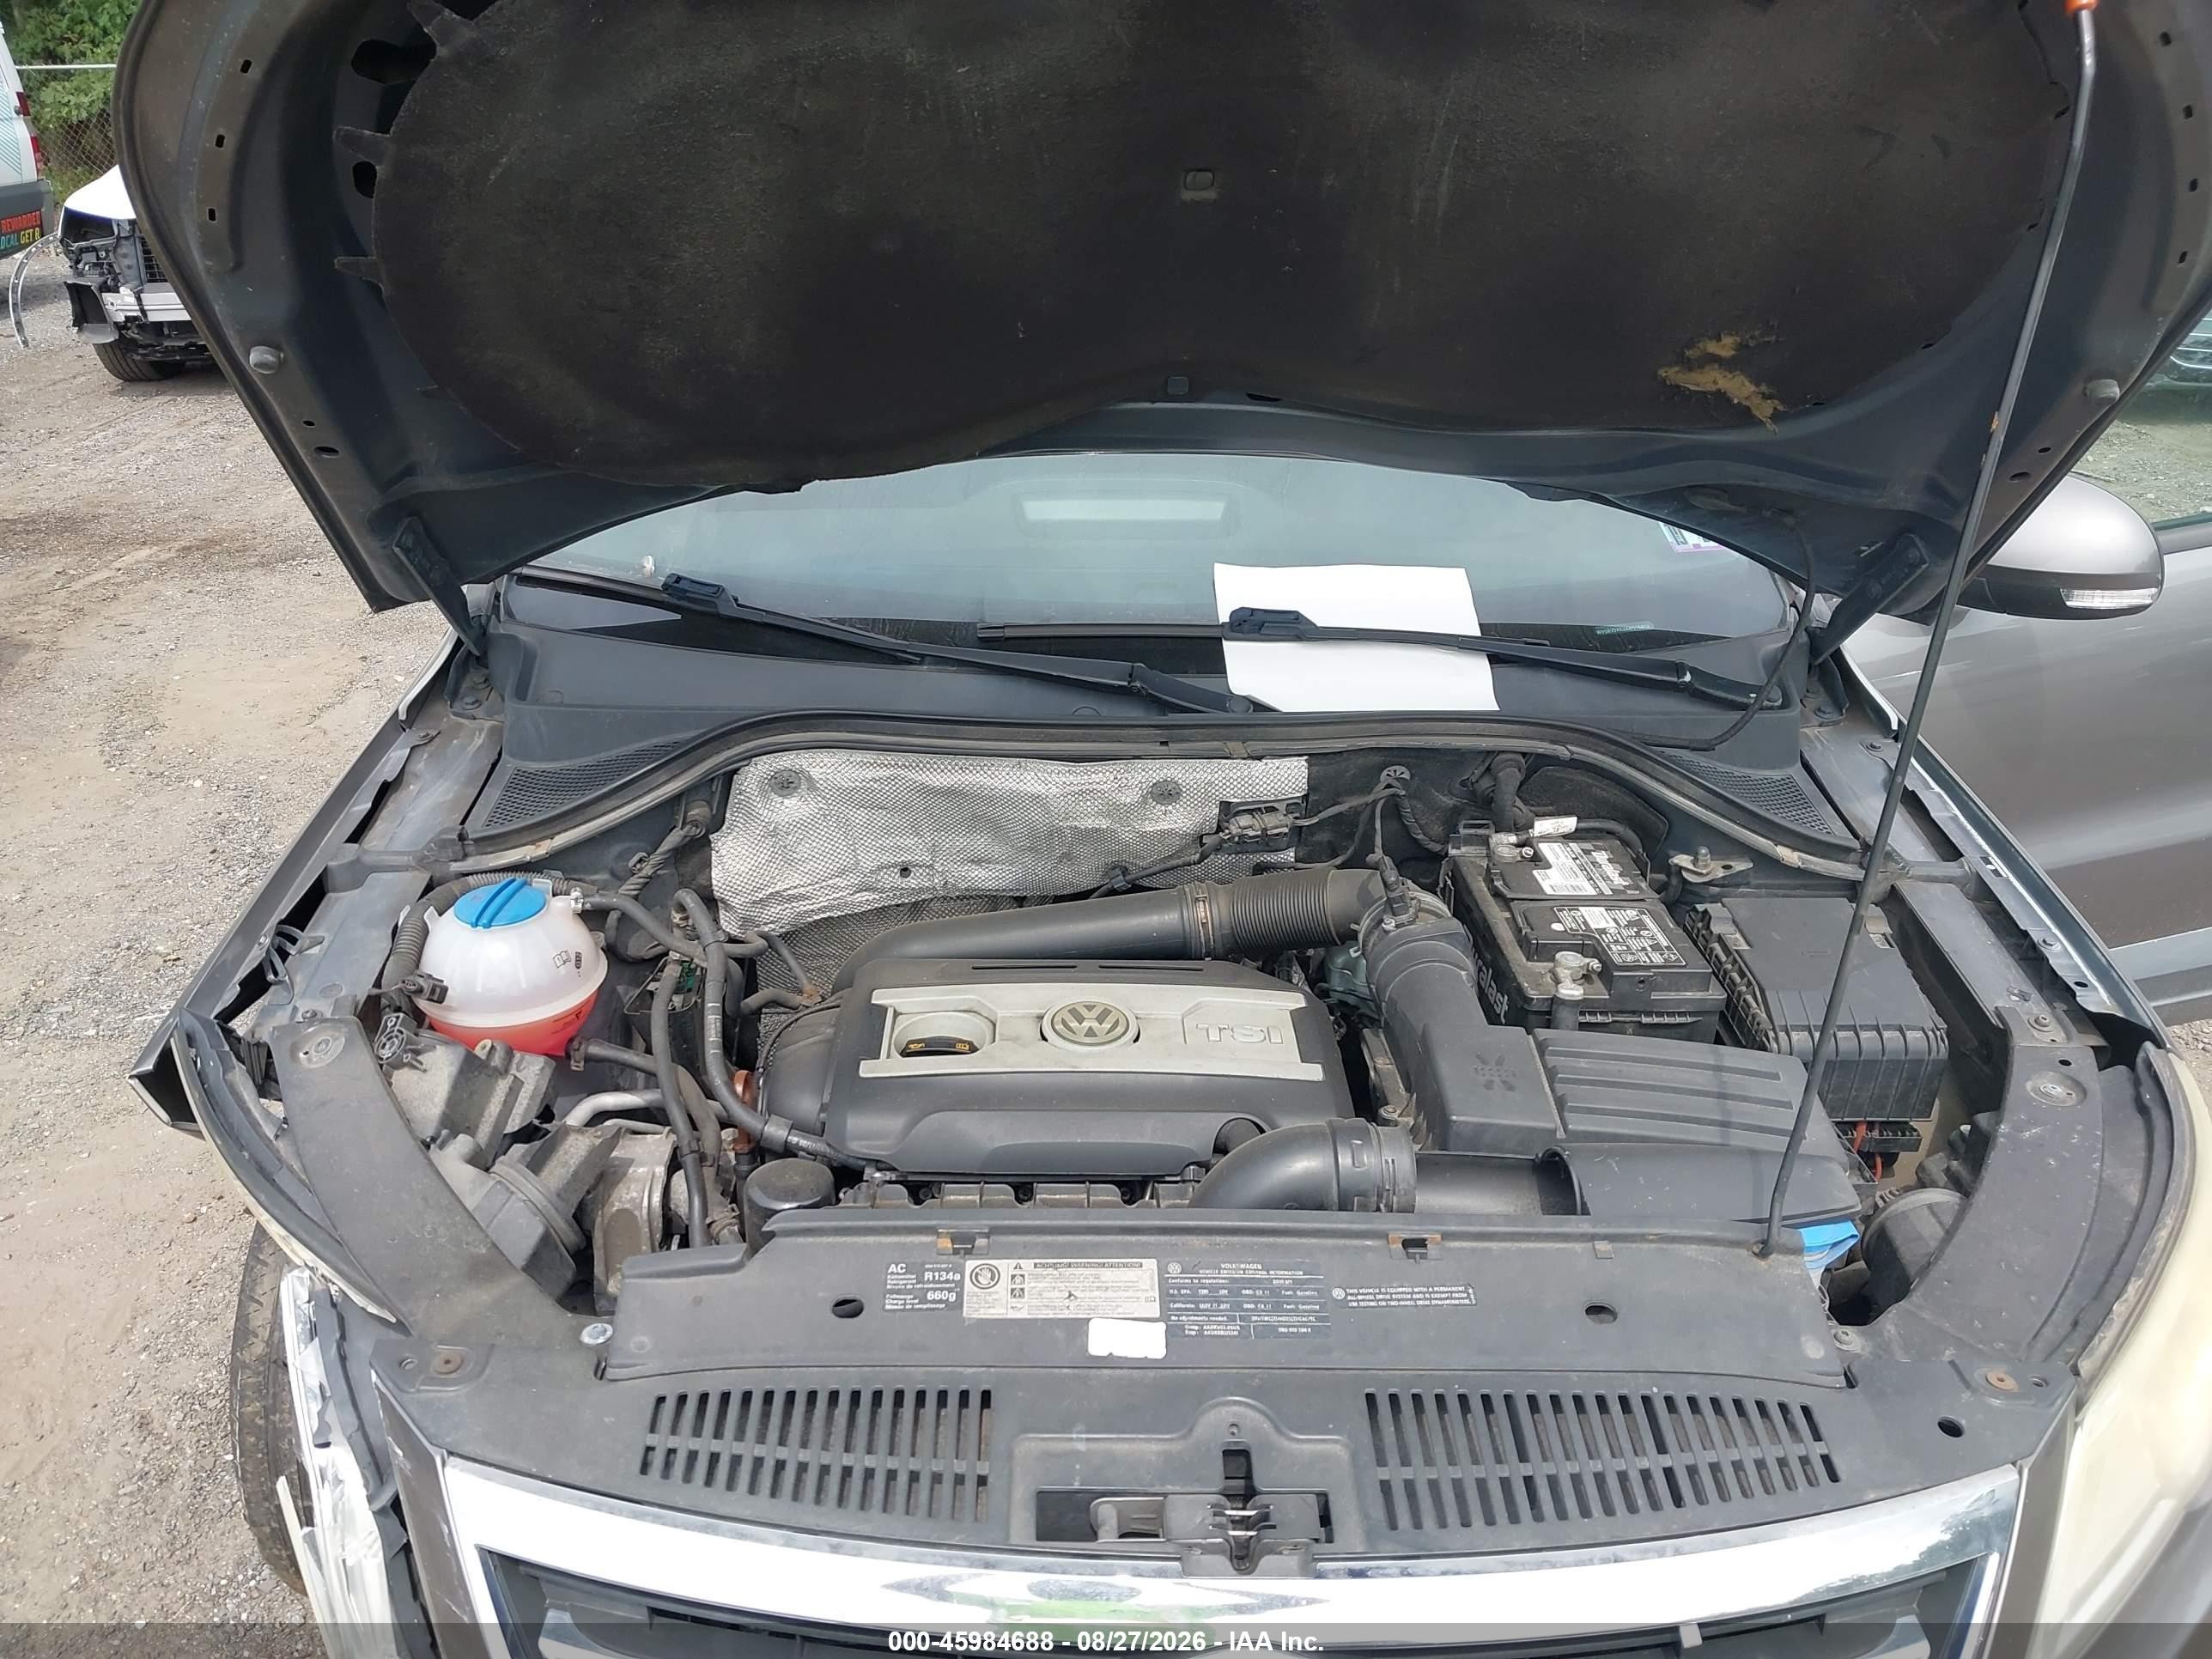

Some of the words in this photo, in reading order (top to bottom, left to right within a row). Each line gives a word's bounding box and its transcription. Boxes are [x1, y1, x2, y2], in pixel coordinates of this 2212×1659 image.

[0, 233, 20, 249] OCAL
[21, 228, 34, 244] GET
[1196, 1024, 1283, 1044] TSI
[887, 1263, 907, 1273] AC
[924, 1271, 961, 1281] R134a
[927, 1290, 957, 1302] 660g
